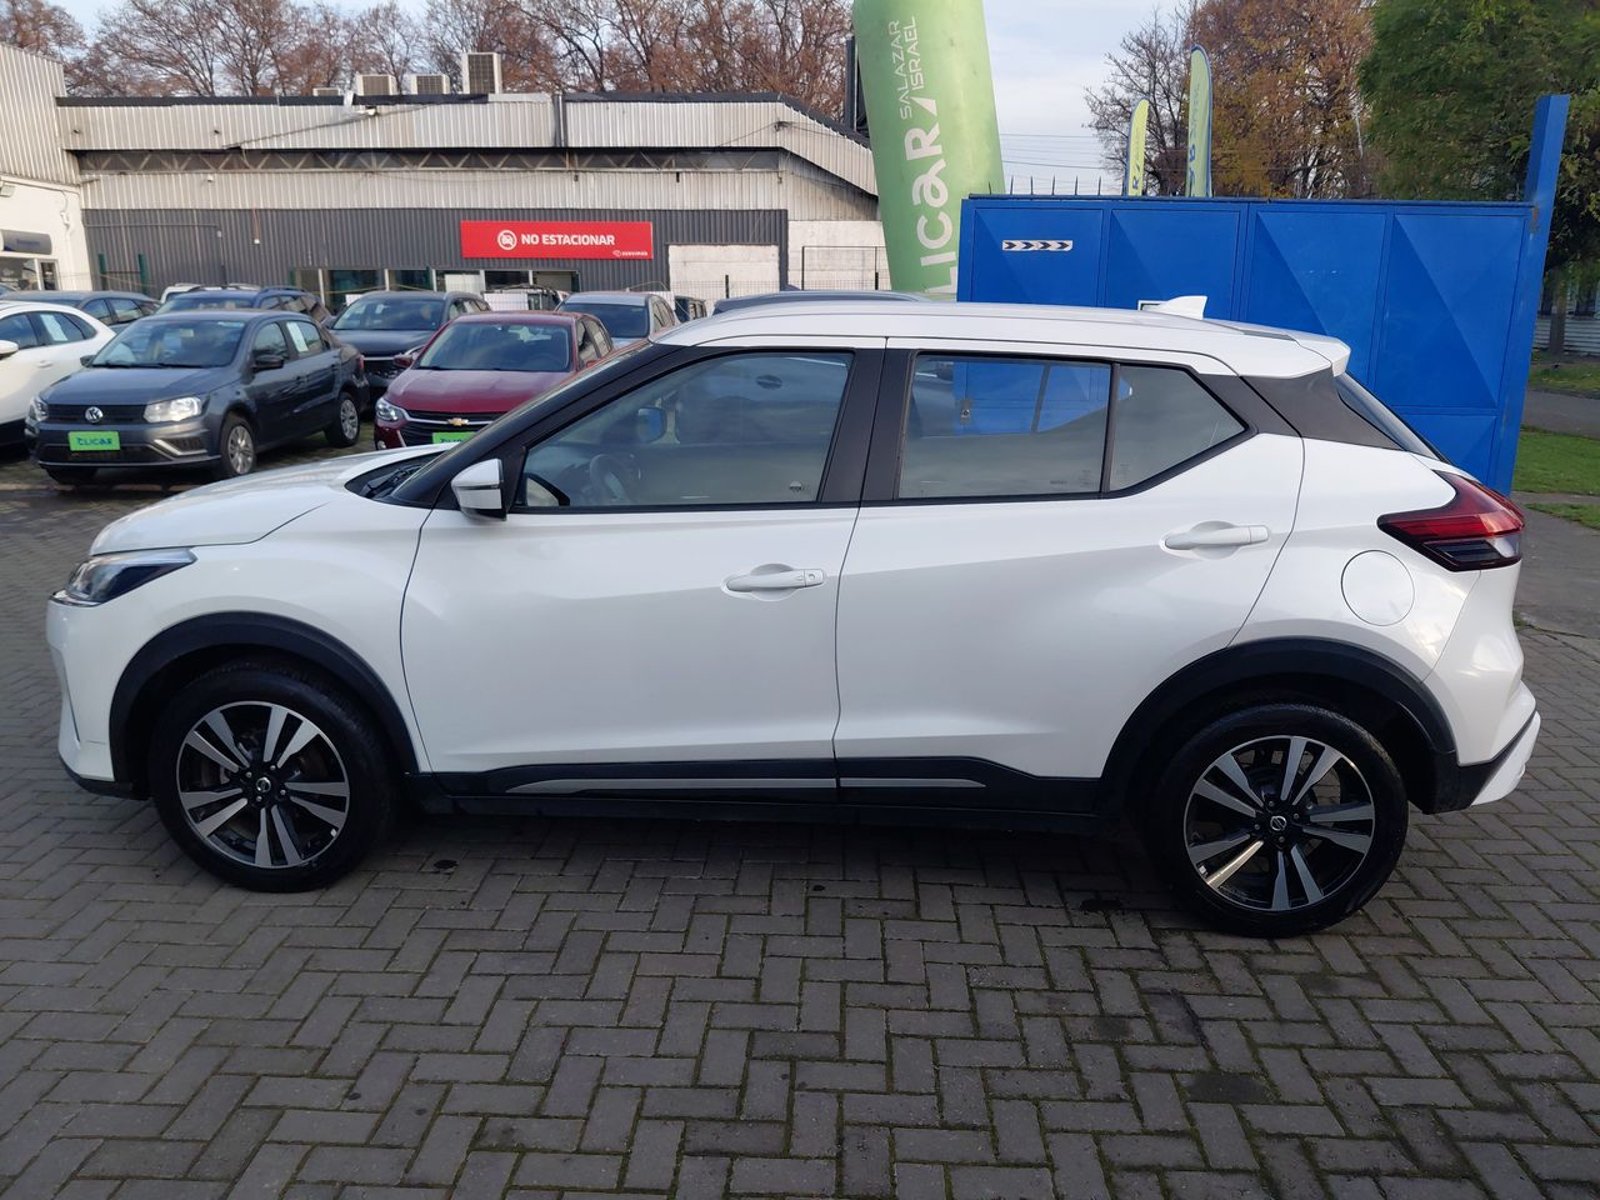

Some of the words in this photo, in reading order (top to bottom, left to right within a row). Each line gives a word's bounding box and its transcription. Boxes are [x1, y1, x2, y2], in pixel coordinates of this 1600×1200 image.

[888, 19, 913, 121] SALAZAR
[904, 16, 925, 91] ISRAEL
[520, 233, 540, 245] NO
[541, 233, 616, 246] ESTACIONAR
